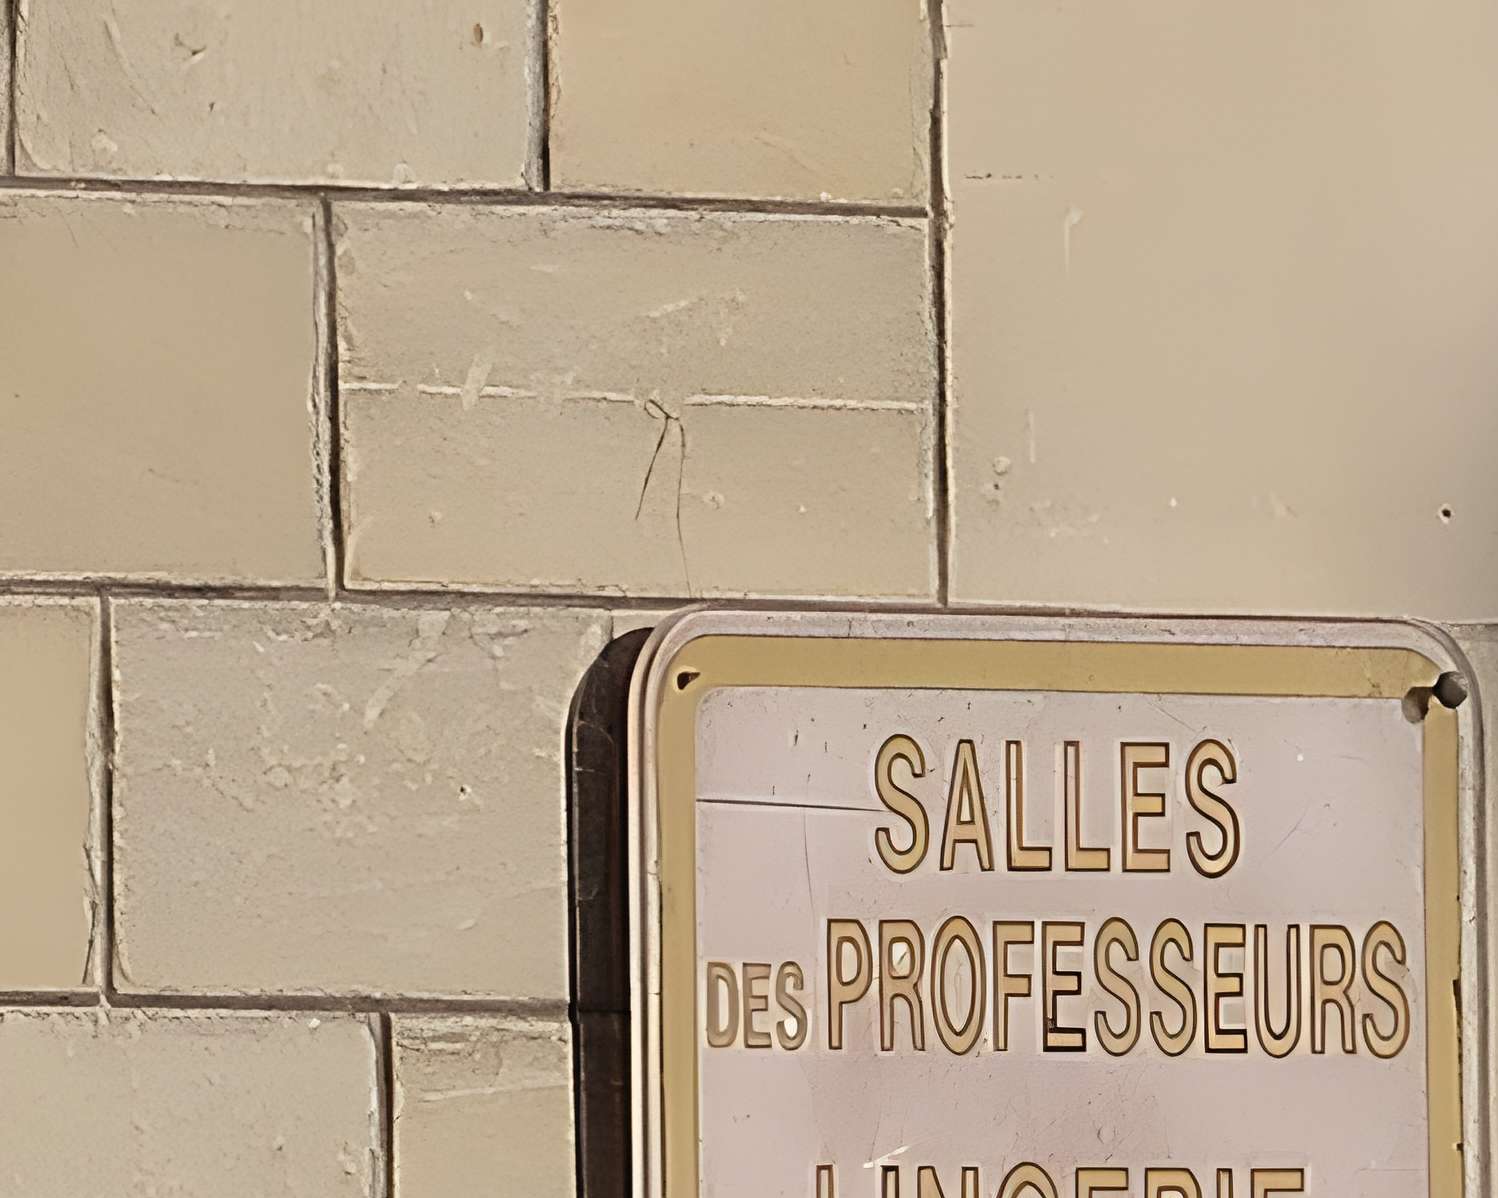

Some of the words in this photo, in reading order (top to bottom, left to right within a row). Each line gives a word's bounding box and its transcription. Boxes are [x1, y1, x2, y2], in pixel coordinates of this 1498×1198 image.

[874, 734, 1241, 878] SALLES
[706, 961, 808, 1051] DES
[826, 915, 1412, 1059] PROFESSEURS
